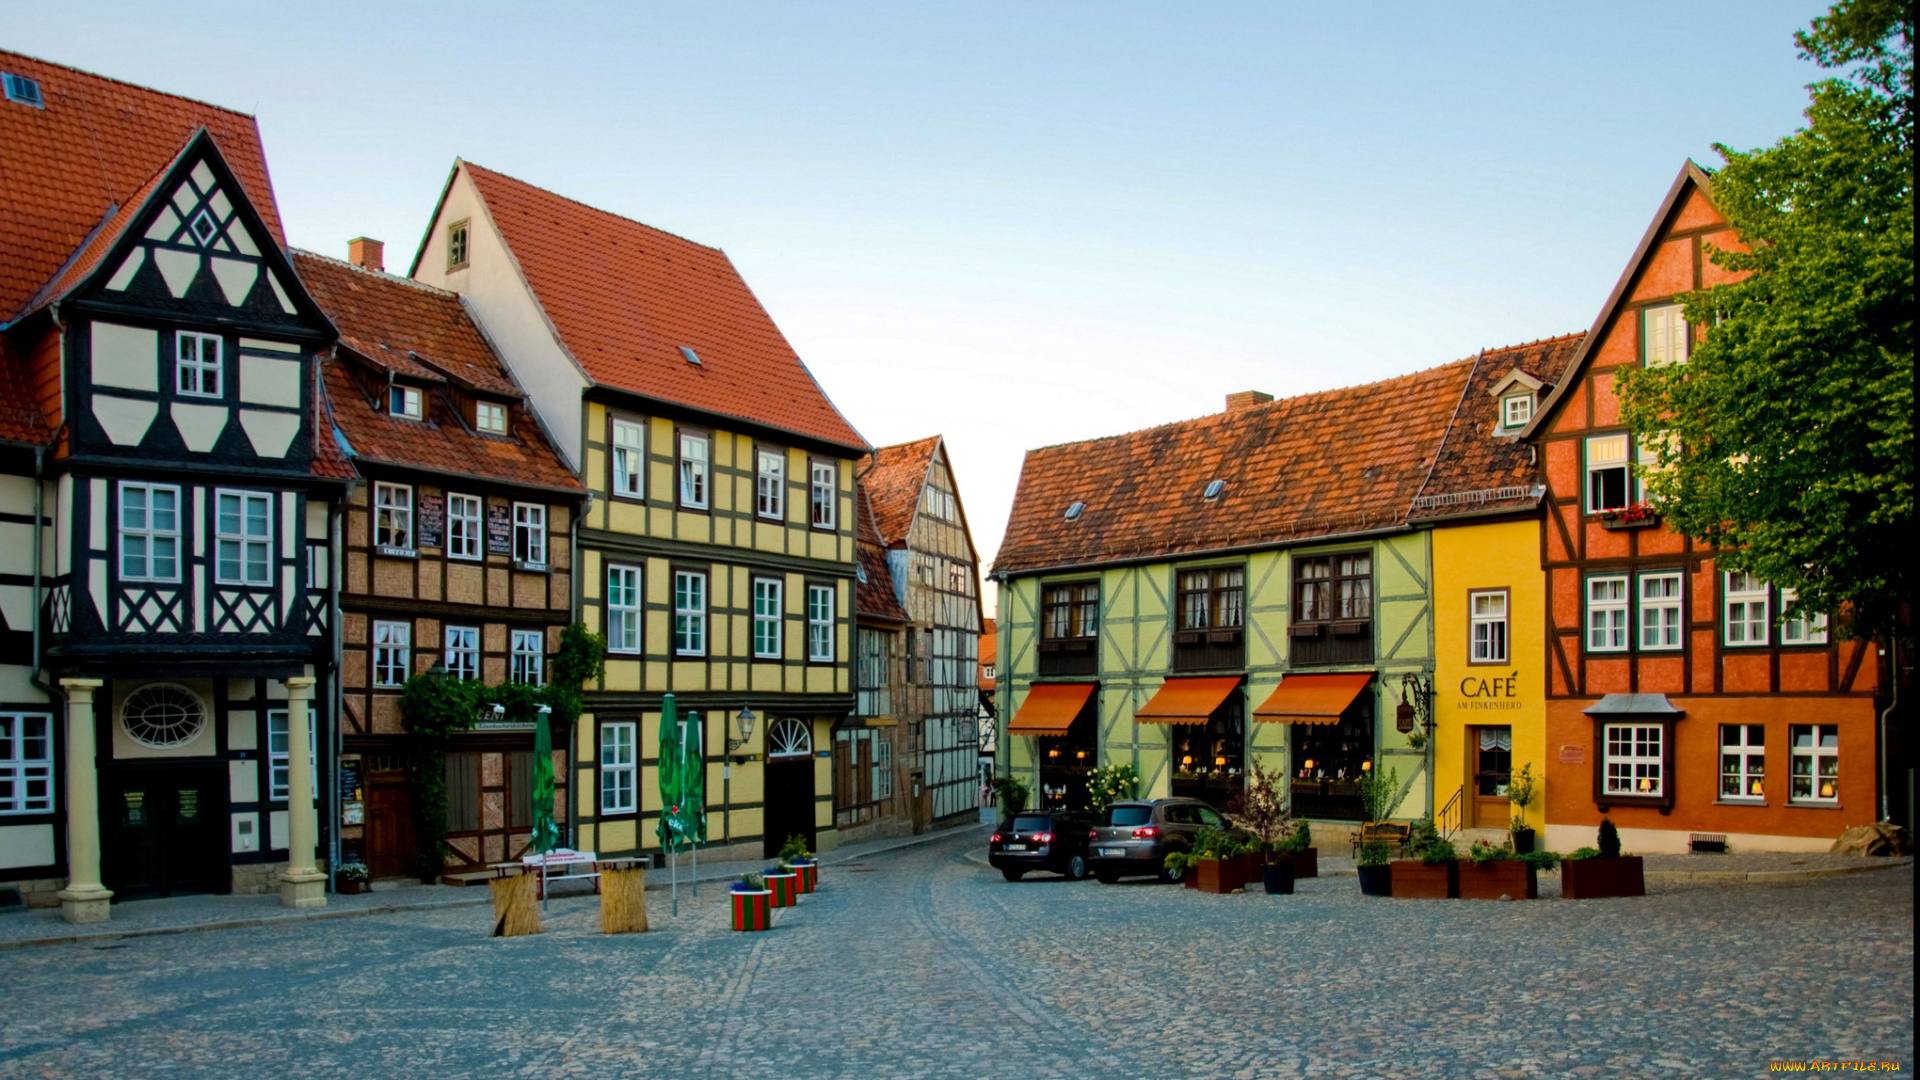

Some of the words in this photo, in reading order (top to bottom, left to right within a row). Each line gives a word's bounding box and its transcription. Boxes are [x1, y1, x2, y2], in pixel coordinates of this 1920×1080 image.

[1460, 671, 1517, 698] CAFÉ
[1456, 701, 1468, 710] AM
[1471, 701, 1522, 710] FINKENHERD
